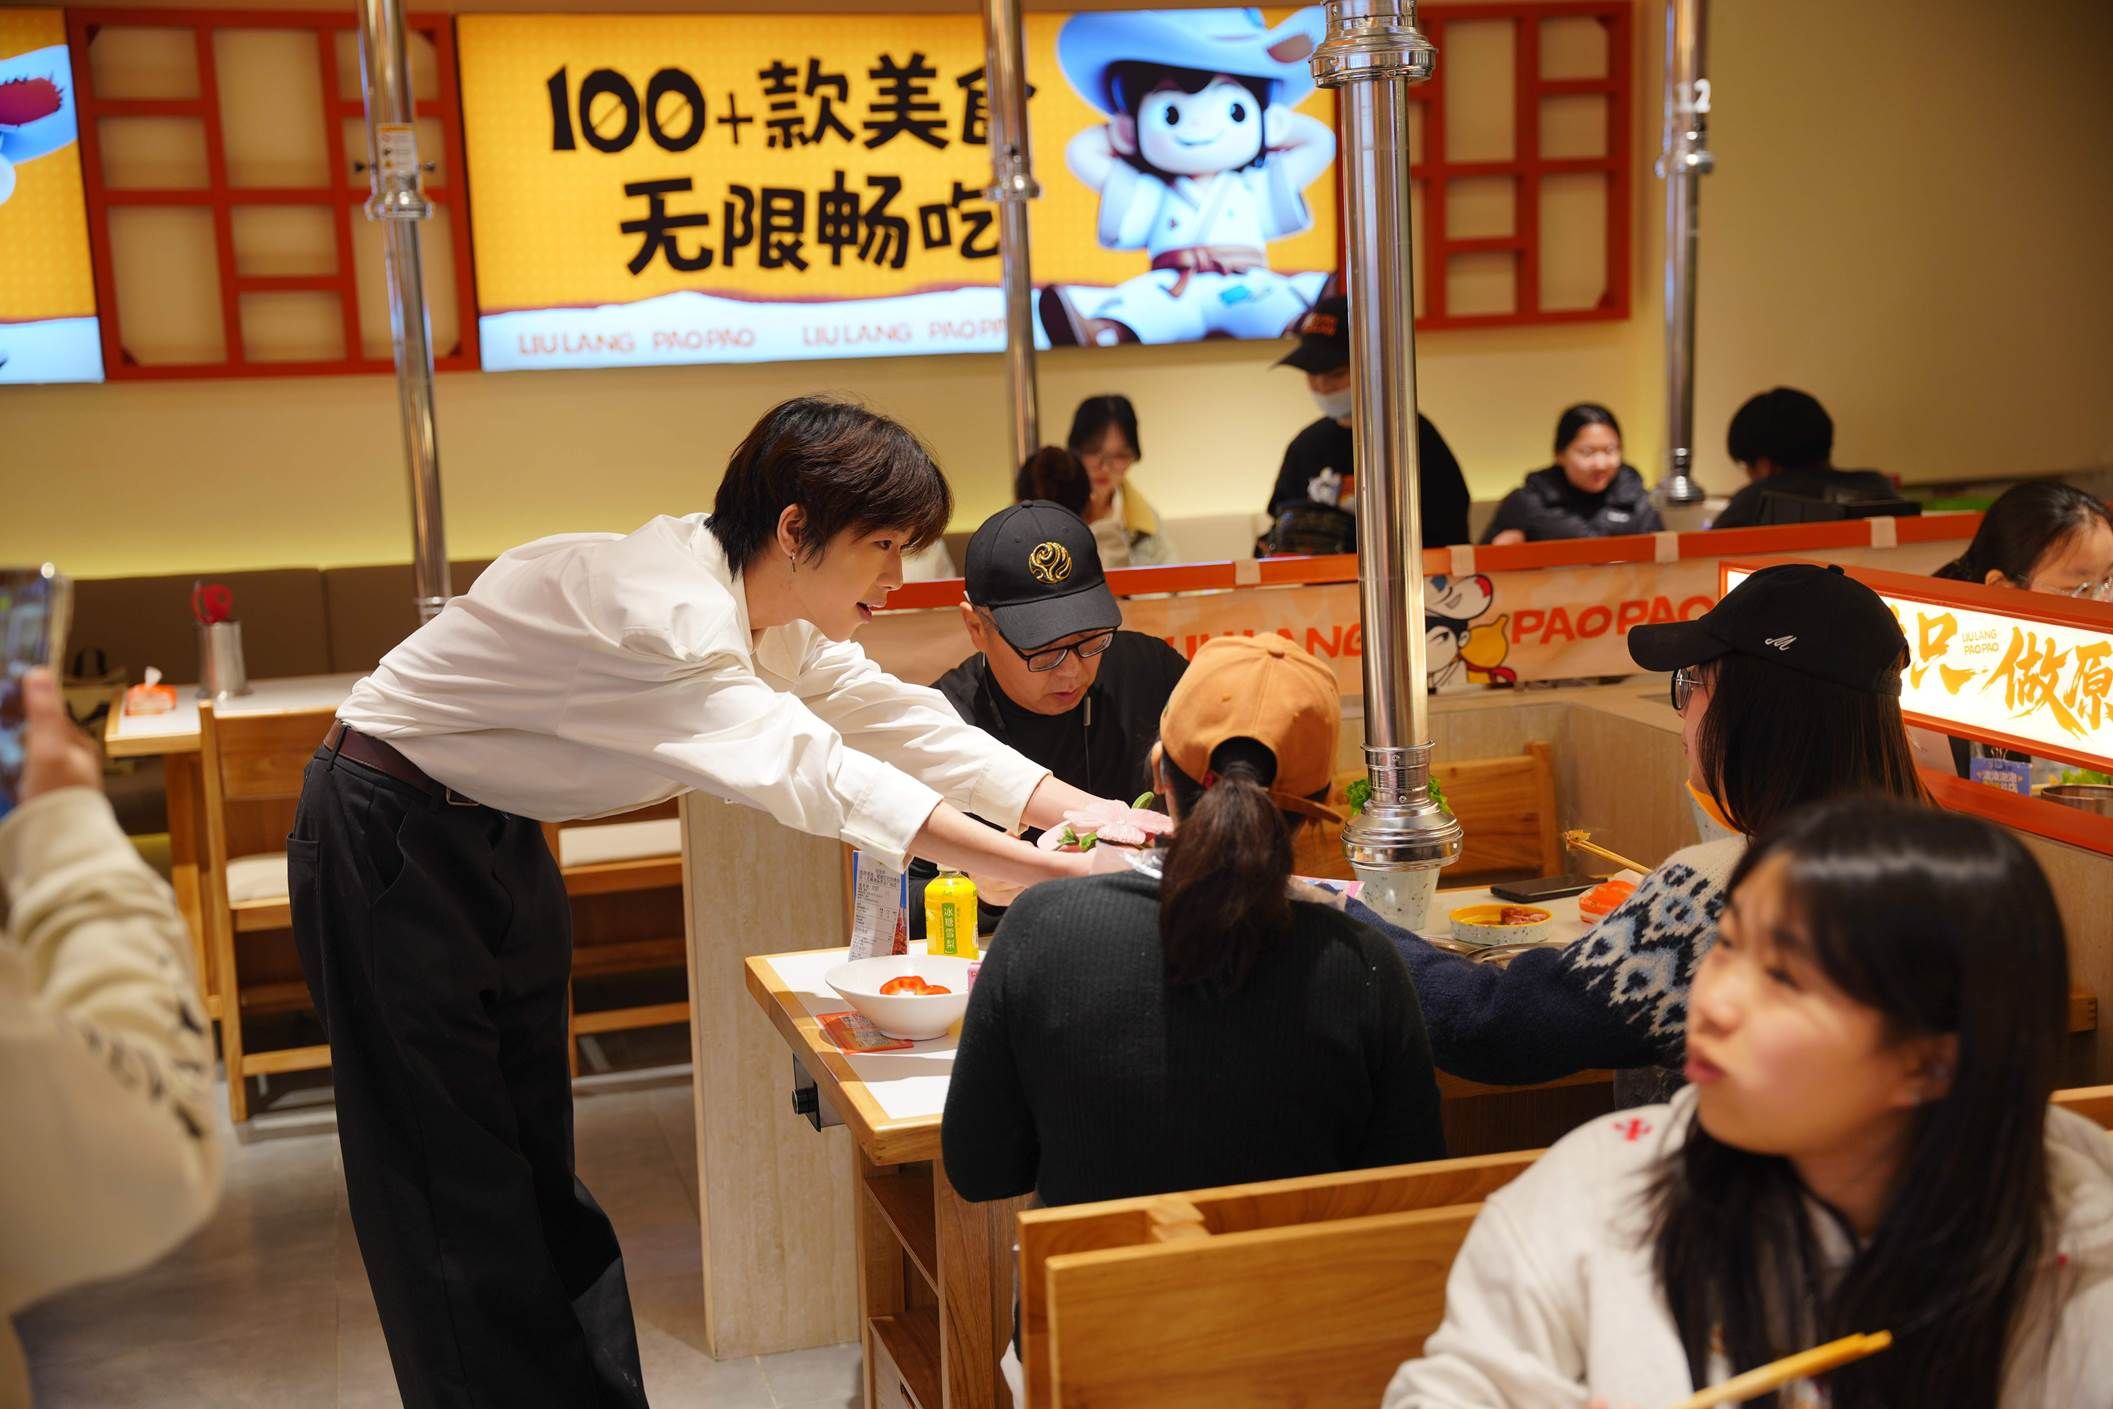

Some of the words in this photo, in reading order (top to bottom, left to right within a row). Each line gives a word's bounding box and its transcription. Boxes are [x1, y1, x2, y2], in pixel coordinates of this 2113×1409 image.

[620, 169, 999, 276] 无限畅吃
[1889, 604, 2113, 742] 只做原
